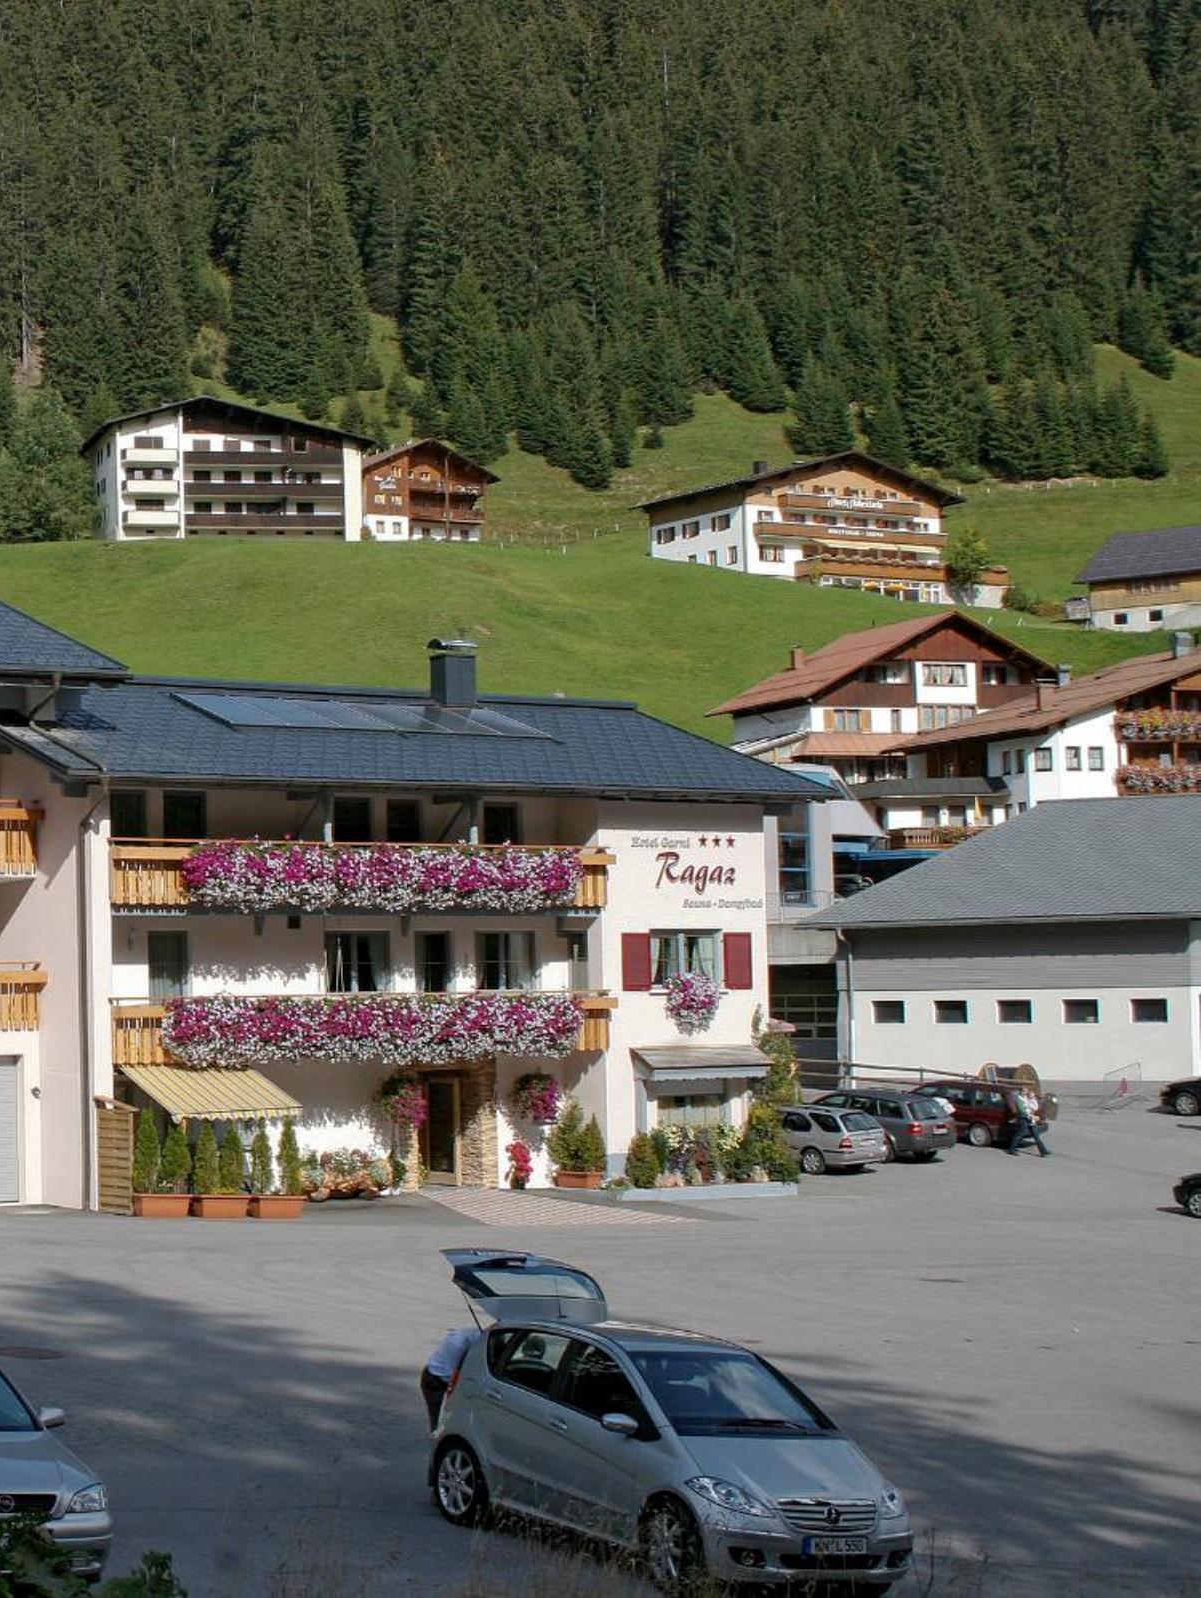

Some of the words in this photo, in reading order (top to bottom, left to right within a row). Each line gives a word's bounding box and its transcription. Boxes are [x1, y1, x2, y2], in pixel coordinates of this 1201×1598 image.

[631, 837, 659, 848] Hotel
[661, 837, 690, 849] Garni
[655, 851, 736, 895] Ragaz
